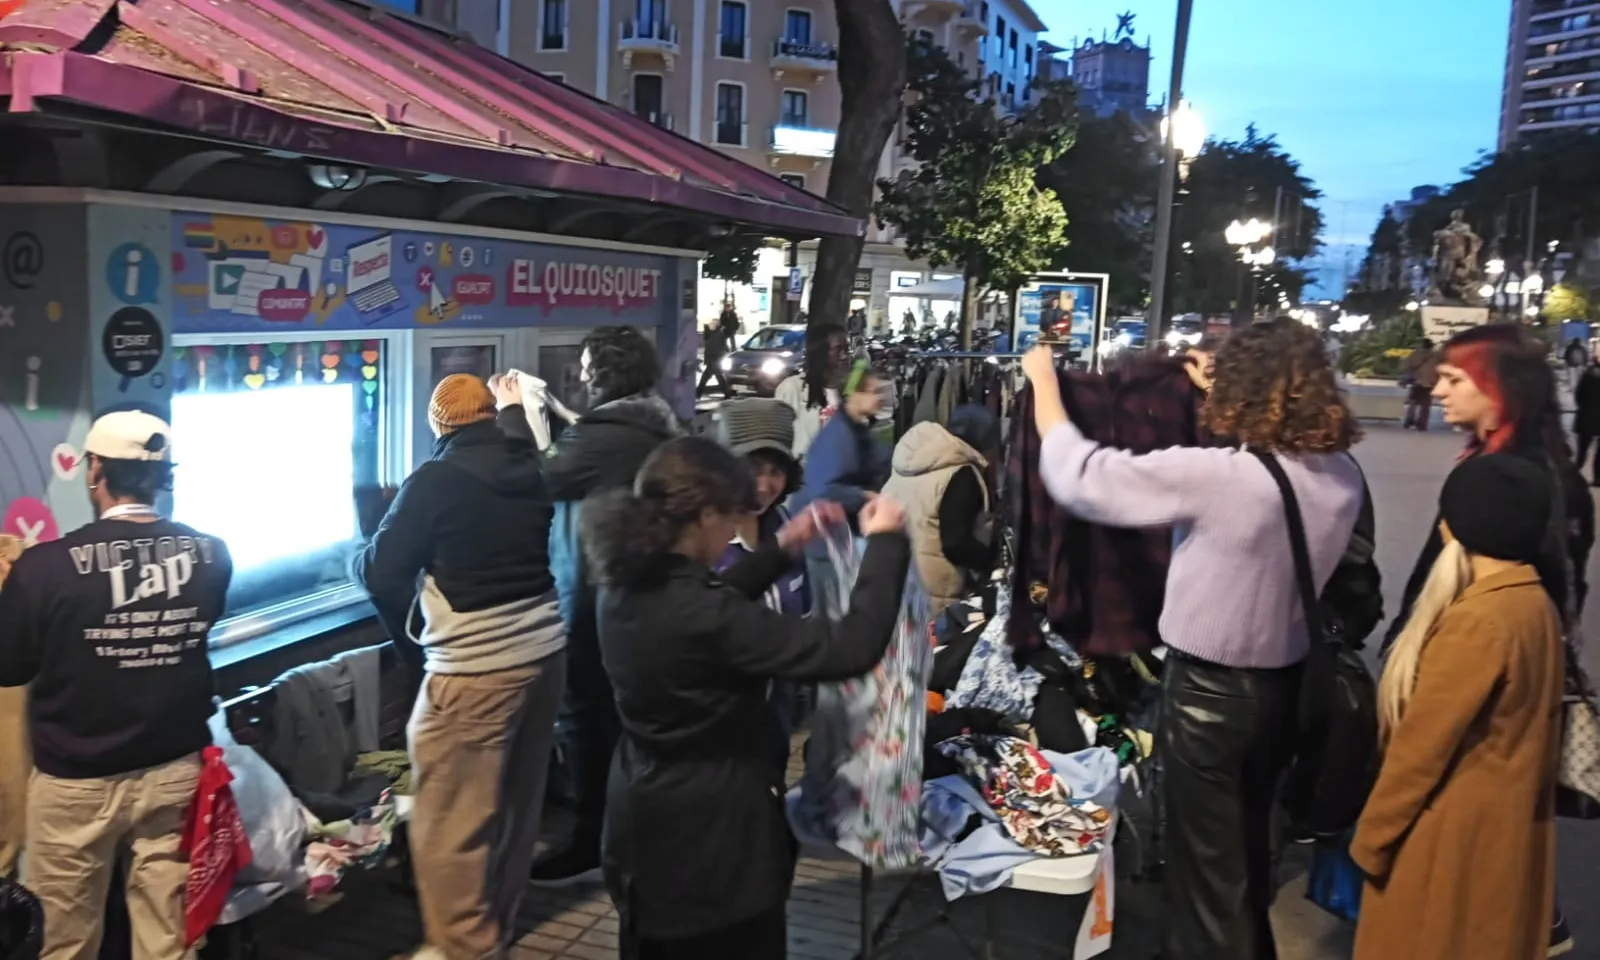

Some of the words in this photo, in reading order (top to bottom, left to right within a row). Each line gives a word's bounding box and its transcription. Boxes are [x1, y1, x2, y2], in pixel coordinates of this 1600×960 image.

[512, 258, 542, 294] EL
[543, 260, 662, 305] QUIOSQUET
[68, 535, 213, 575] VICTORY
[109, 551, 194, 609] Lap
